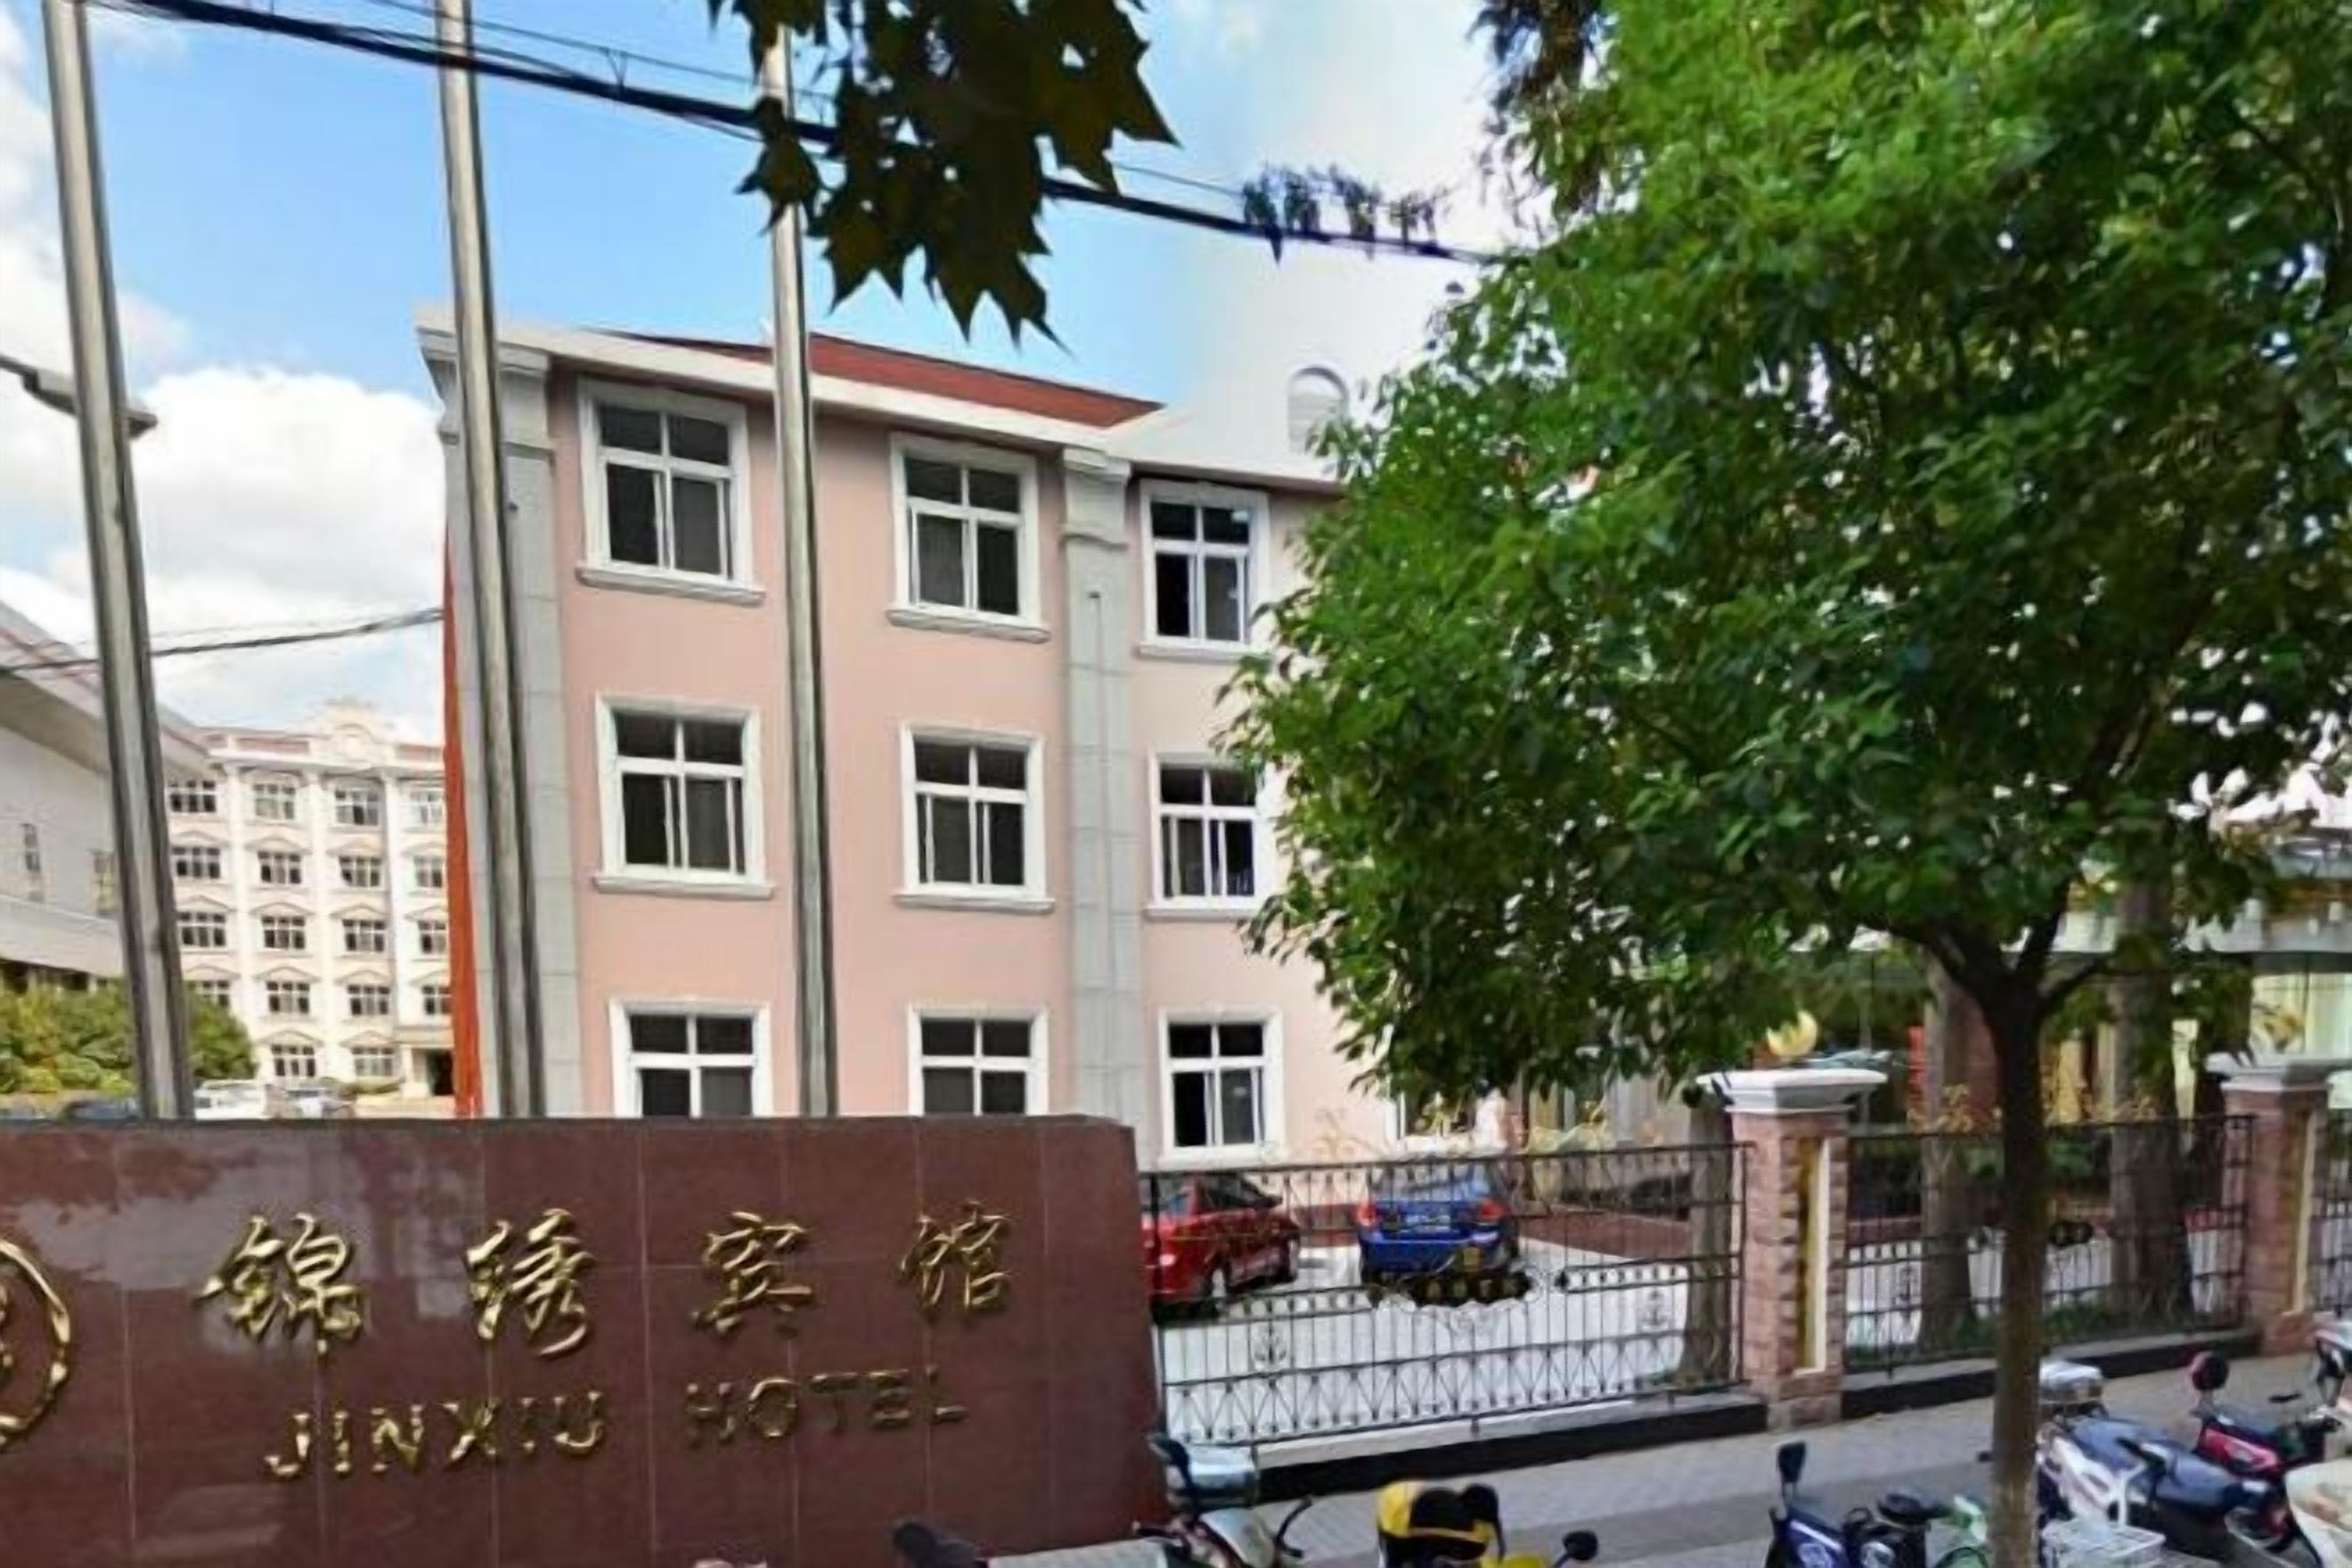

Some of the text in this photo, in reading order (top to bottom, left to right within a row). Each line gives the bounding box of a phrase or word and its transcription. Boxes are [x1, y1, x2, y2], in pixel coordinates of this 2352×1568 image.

[195, 1203, 1009, 1358] 锦绣宾馆
[265, 1366, 967, 1478] JINXIU HOTEL
